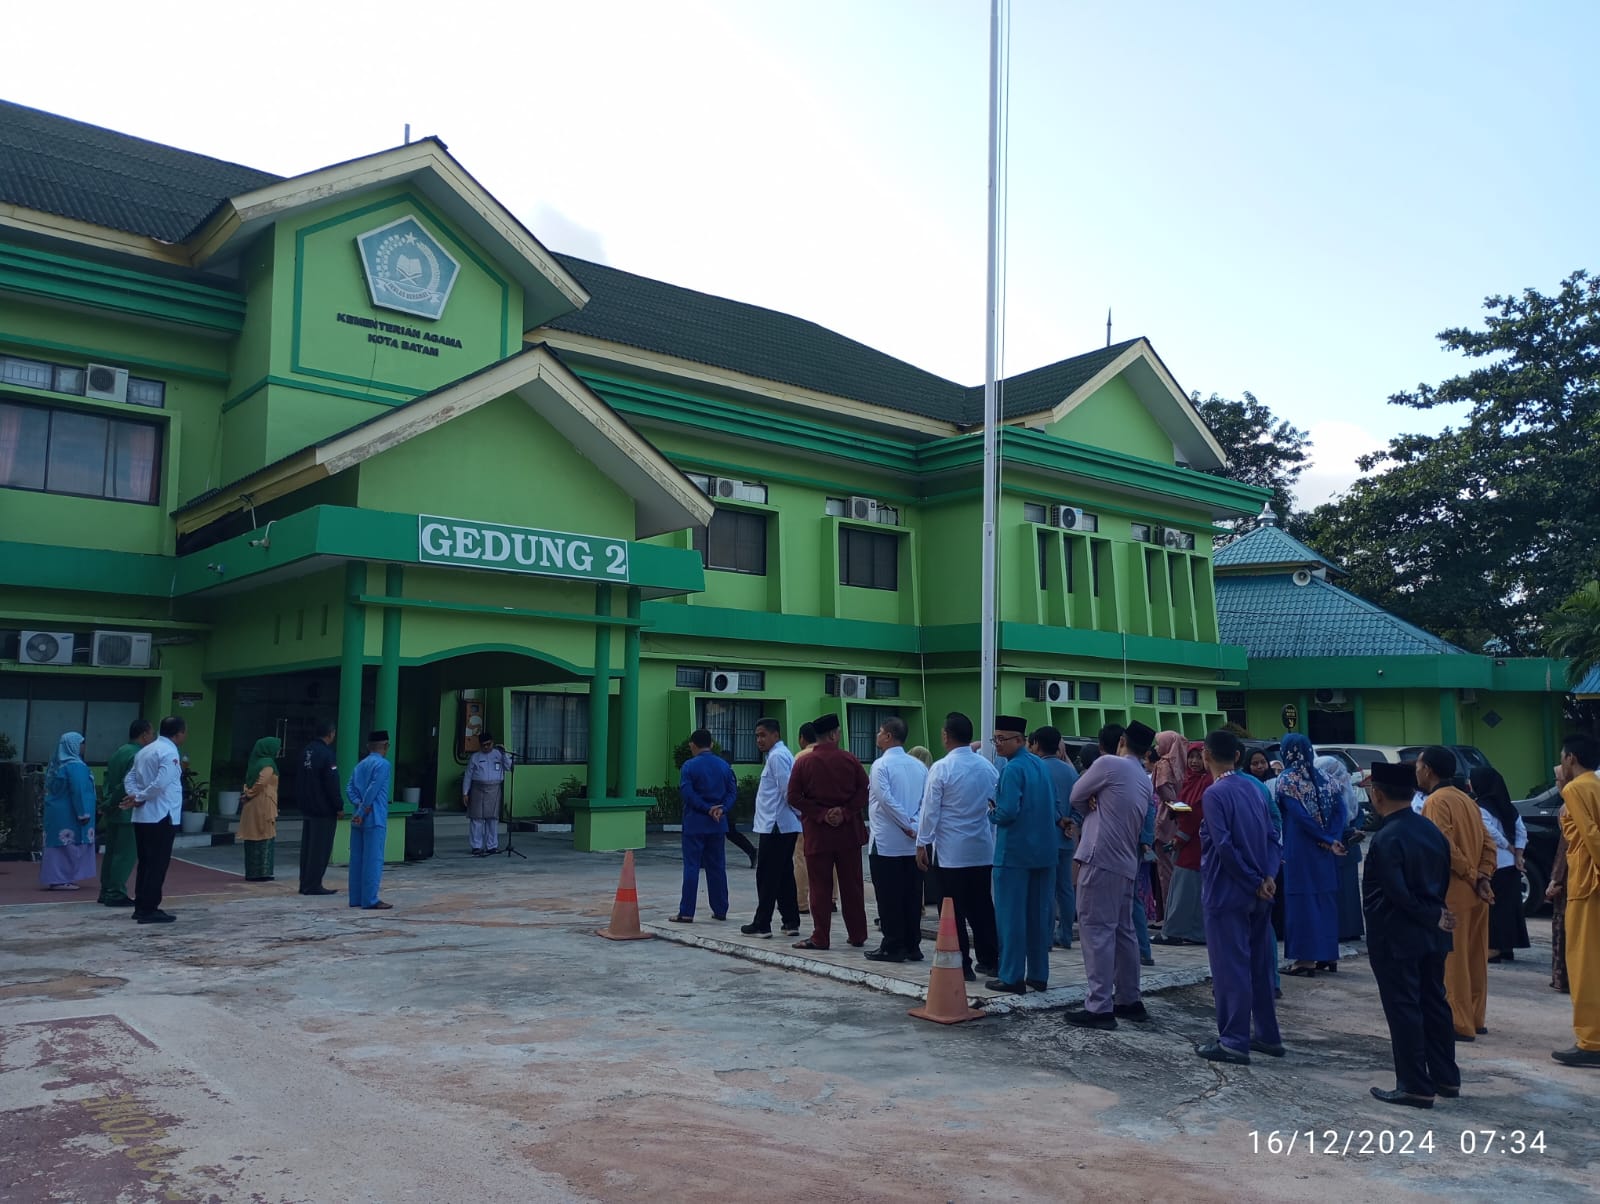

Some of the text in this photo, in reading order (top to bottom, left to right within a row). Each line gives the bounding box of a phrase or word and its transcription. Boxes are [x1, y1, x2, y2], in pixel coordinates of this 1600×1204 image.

[336, 312, 463, 349] KEMENTERIAN AGAMA
[367, 333, 439, 357] KOTA BATAM
[421, 522, 627, 575] GEDUNG 2
